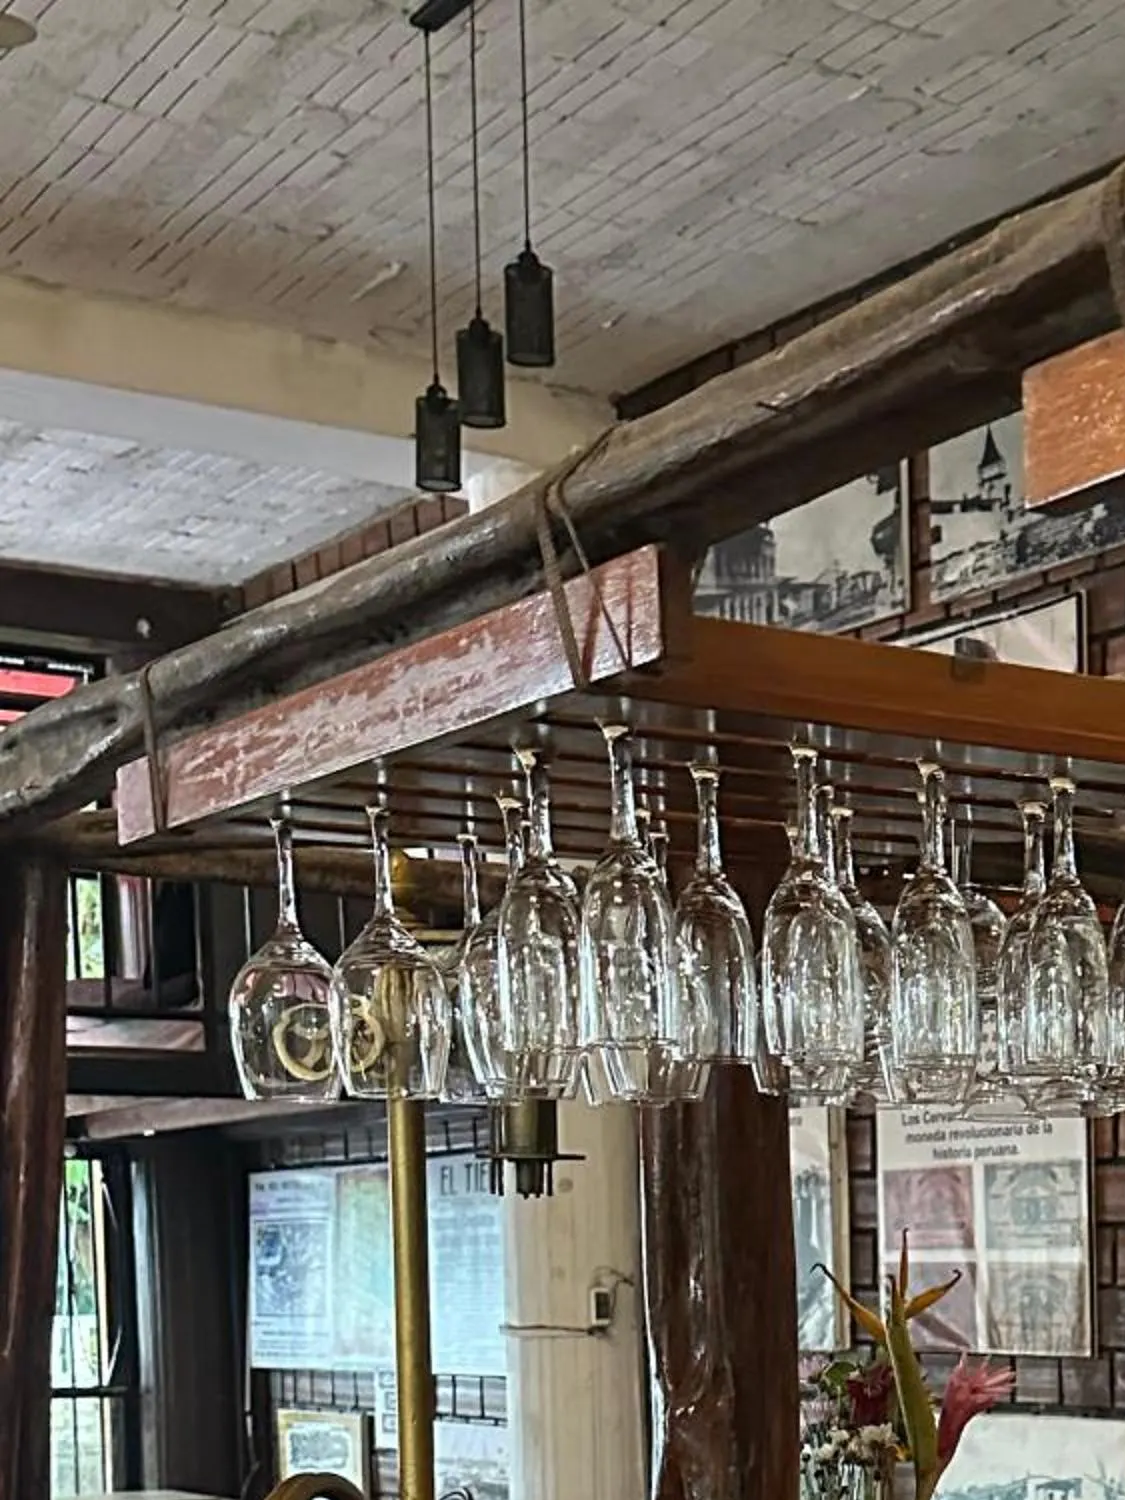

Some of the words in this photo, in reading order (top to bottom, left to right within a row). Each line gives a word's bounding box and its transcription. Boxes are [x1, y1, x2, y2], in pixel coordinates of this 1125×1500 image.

[906, 1129, 946, 1143] moneda
[949, 1124, 1023, 1140] revolucionaria
[1026, 1123, 1040, 1135] de
[1043, 1122, 1053, 1134] la
[932, 1145, 972, 1159] historia
[441, 1165, 457, 1195] EL
[464, 1161, 490, 1193] TIE
